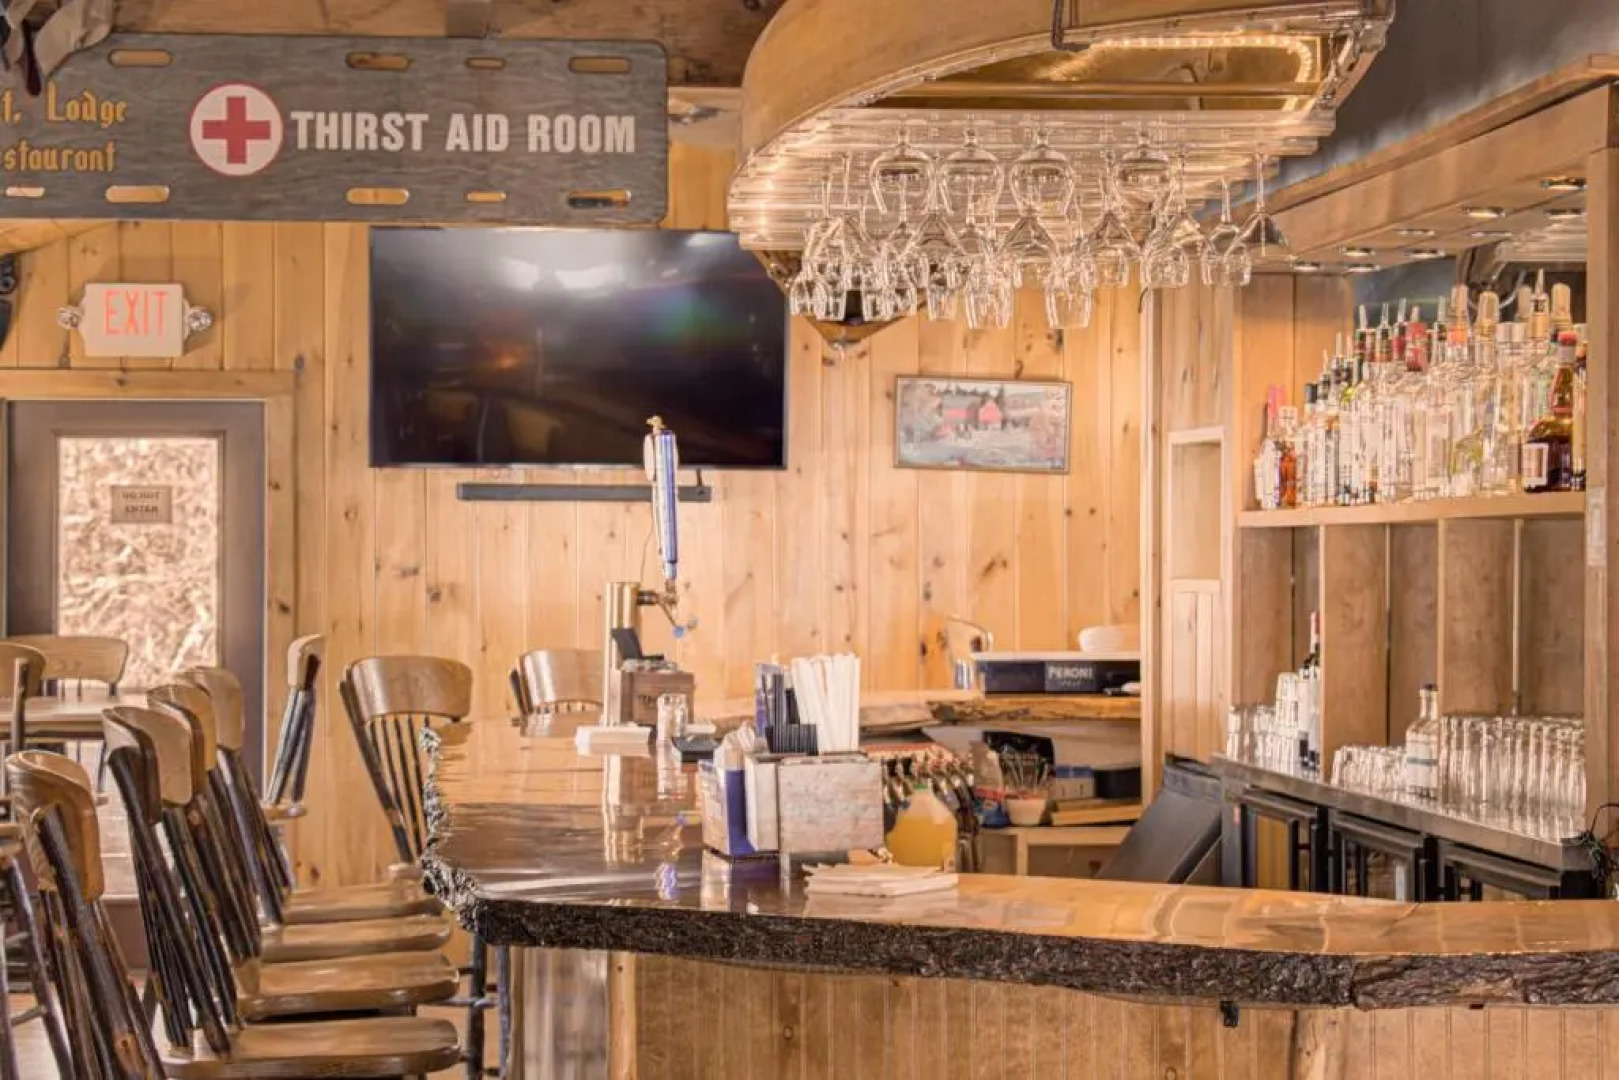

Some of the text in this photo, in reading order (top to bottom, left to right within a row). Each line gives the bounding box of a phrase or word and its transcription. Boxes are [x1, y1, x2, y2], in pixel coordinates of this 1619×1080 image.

[46, 80, 128, 129] Lodge
[291, 110, 636, 153] THIRST AID ROOM
[3, 139, 116, 172] staurant
[104, 289, 169, 337] EXIT
